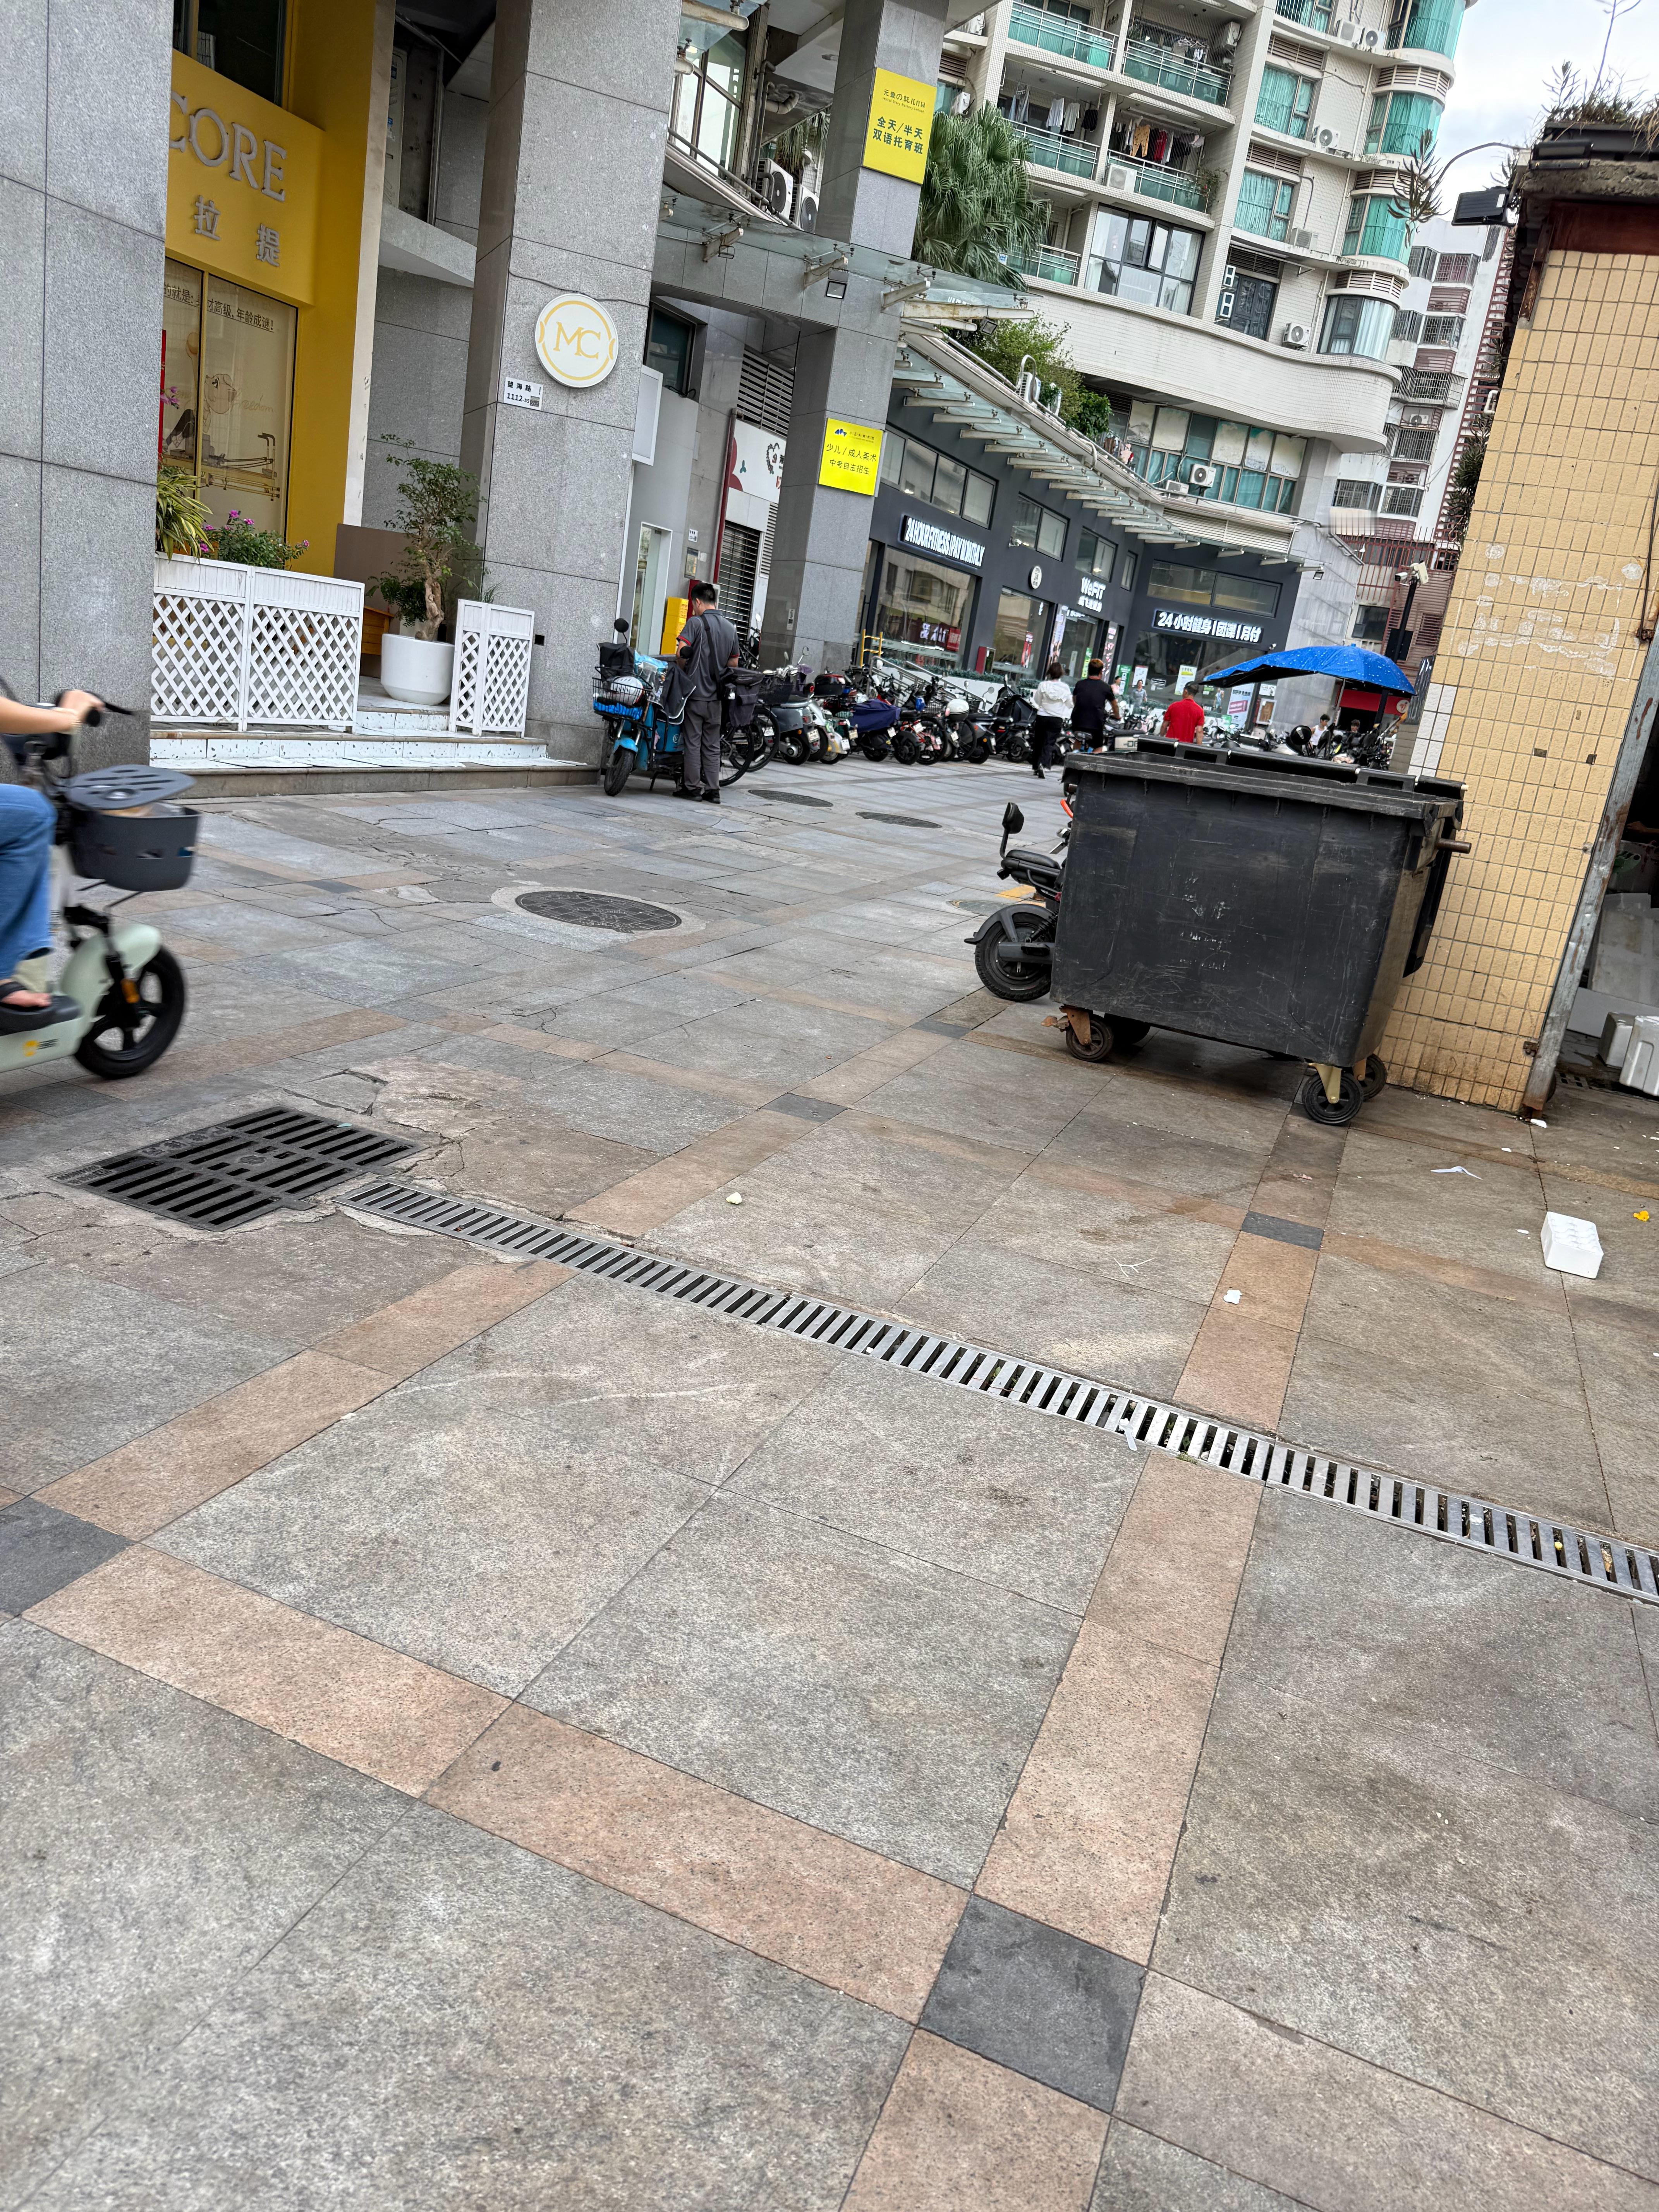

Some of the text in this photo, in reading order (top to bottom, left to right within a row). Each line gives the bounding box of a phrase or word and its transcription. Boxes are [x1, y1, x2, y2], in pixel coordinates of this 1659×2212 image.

[877, 116, 923, 140] 全天/半天
[872, 128, 924, 154] 双语托育班
[553, 321, 601, 359] MC
[830, 459, 870, 475] 中考自主招生
